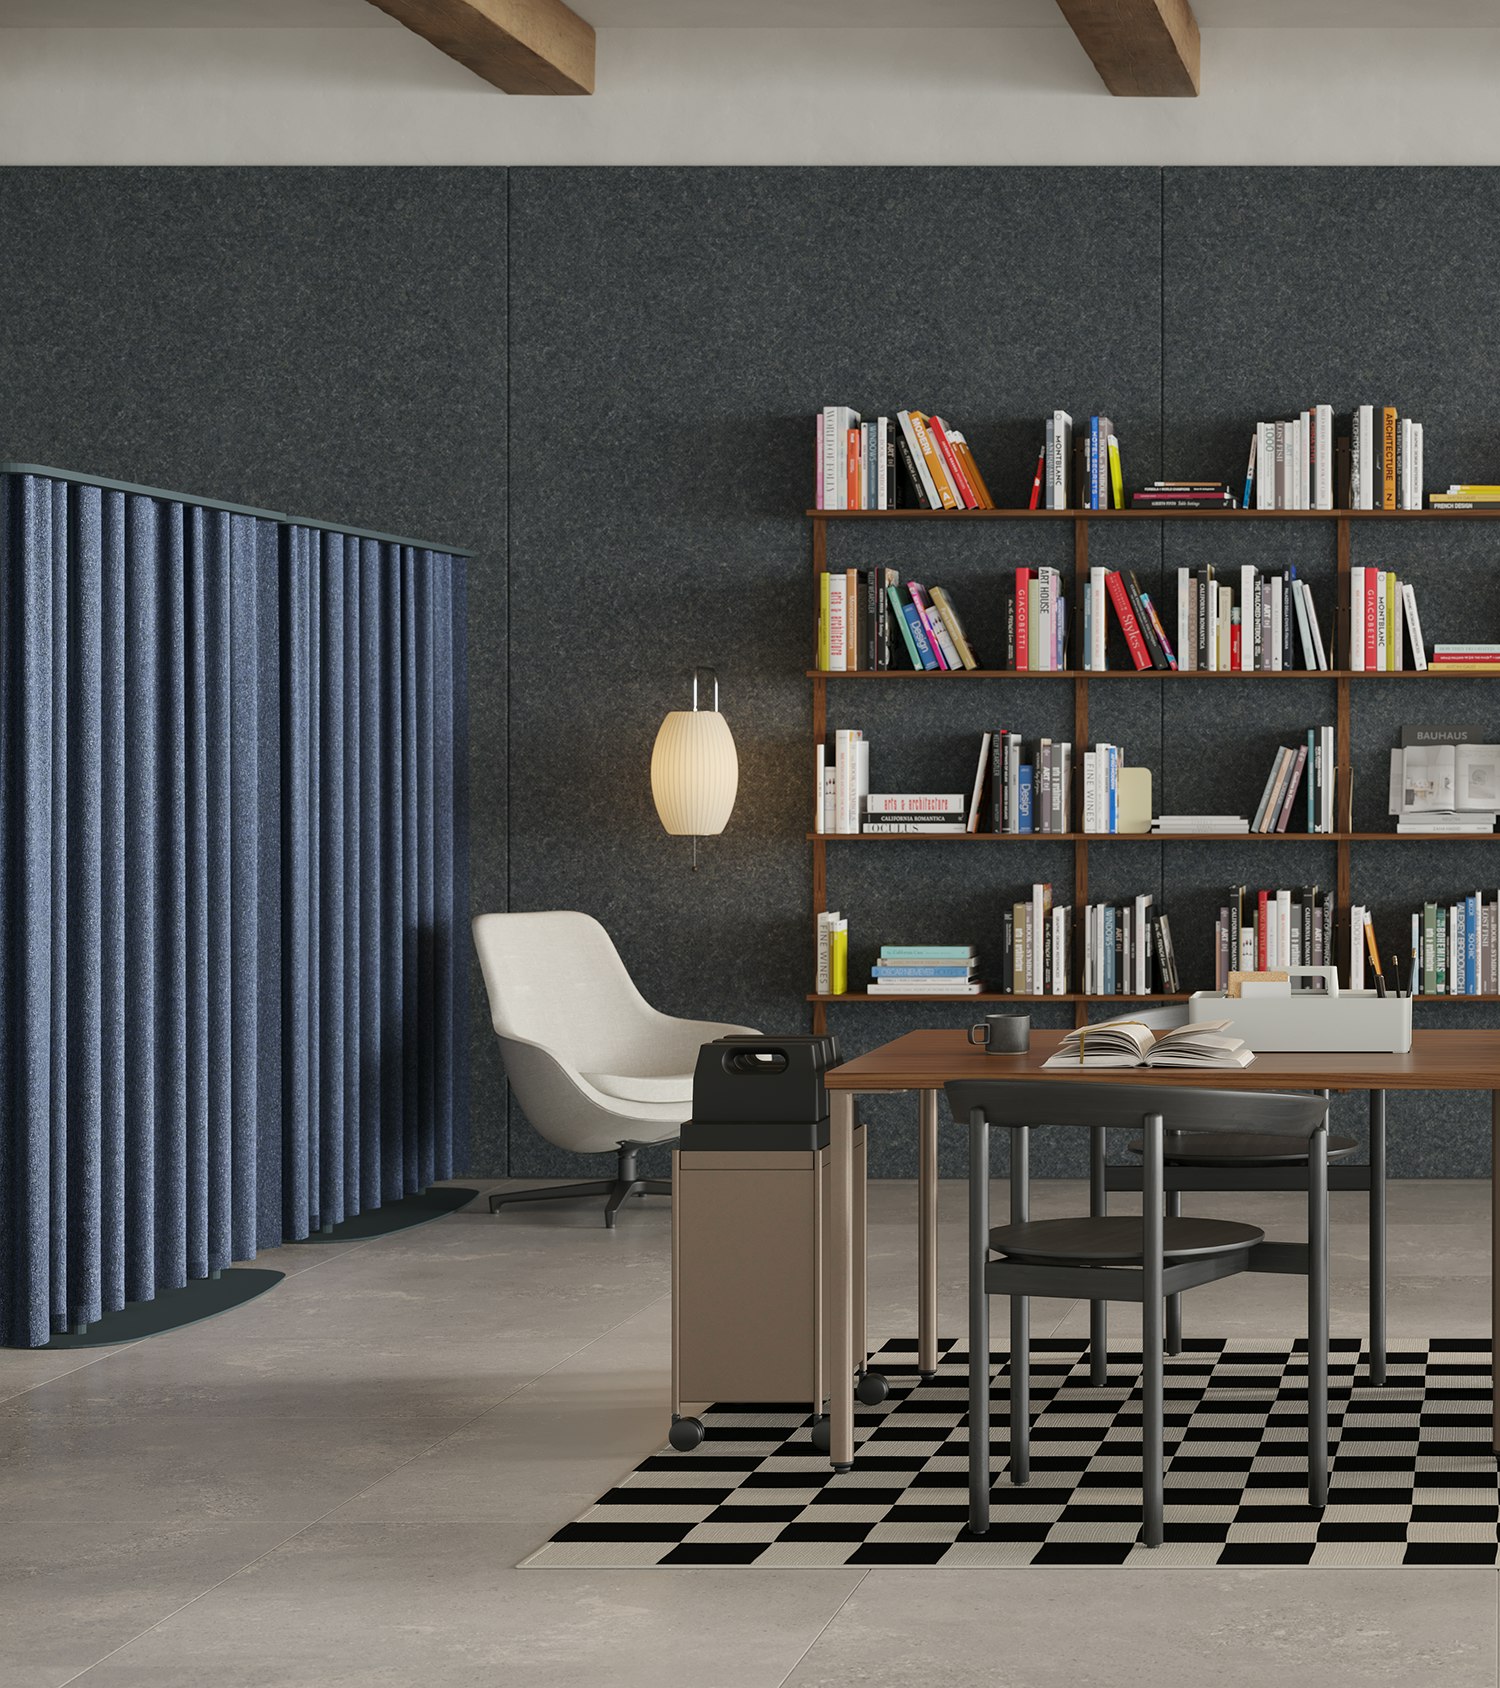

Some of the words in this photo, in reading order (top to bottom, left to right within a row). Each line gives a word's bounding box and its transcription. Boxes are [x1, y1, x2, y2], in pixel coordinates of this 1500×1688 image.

[826, 410, 835, 447] WORLD
[869, 425, 877, 461] WINDOWS
[911, 417, 932, 455] MODERN
[826, 448, 835, 462] OF
[1385, 413, 1393, 480] ARCHITECTURE
[826, 463, 835, 493] FOLLY
[1039, 569, 1049, 585] ART
[1039, 587, 1049, 614] HOUSE
[911, 620, 930, 653] Design
[1122, 614, 1140, 649] Styles
[1417, 731, 1468, 740] BAUHAUS
[1021, 783, 1031, 816] Design
[871, 824, 919, 832] OCULUS
[1354, 910, 1362, 946] WINDOWS
[1467, 933, 1474, 942] SO
[1436, 927, 1445, 972] BOHEMIANS
